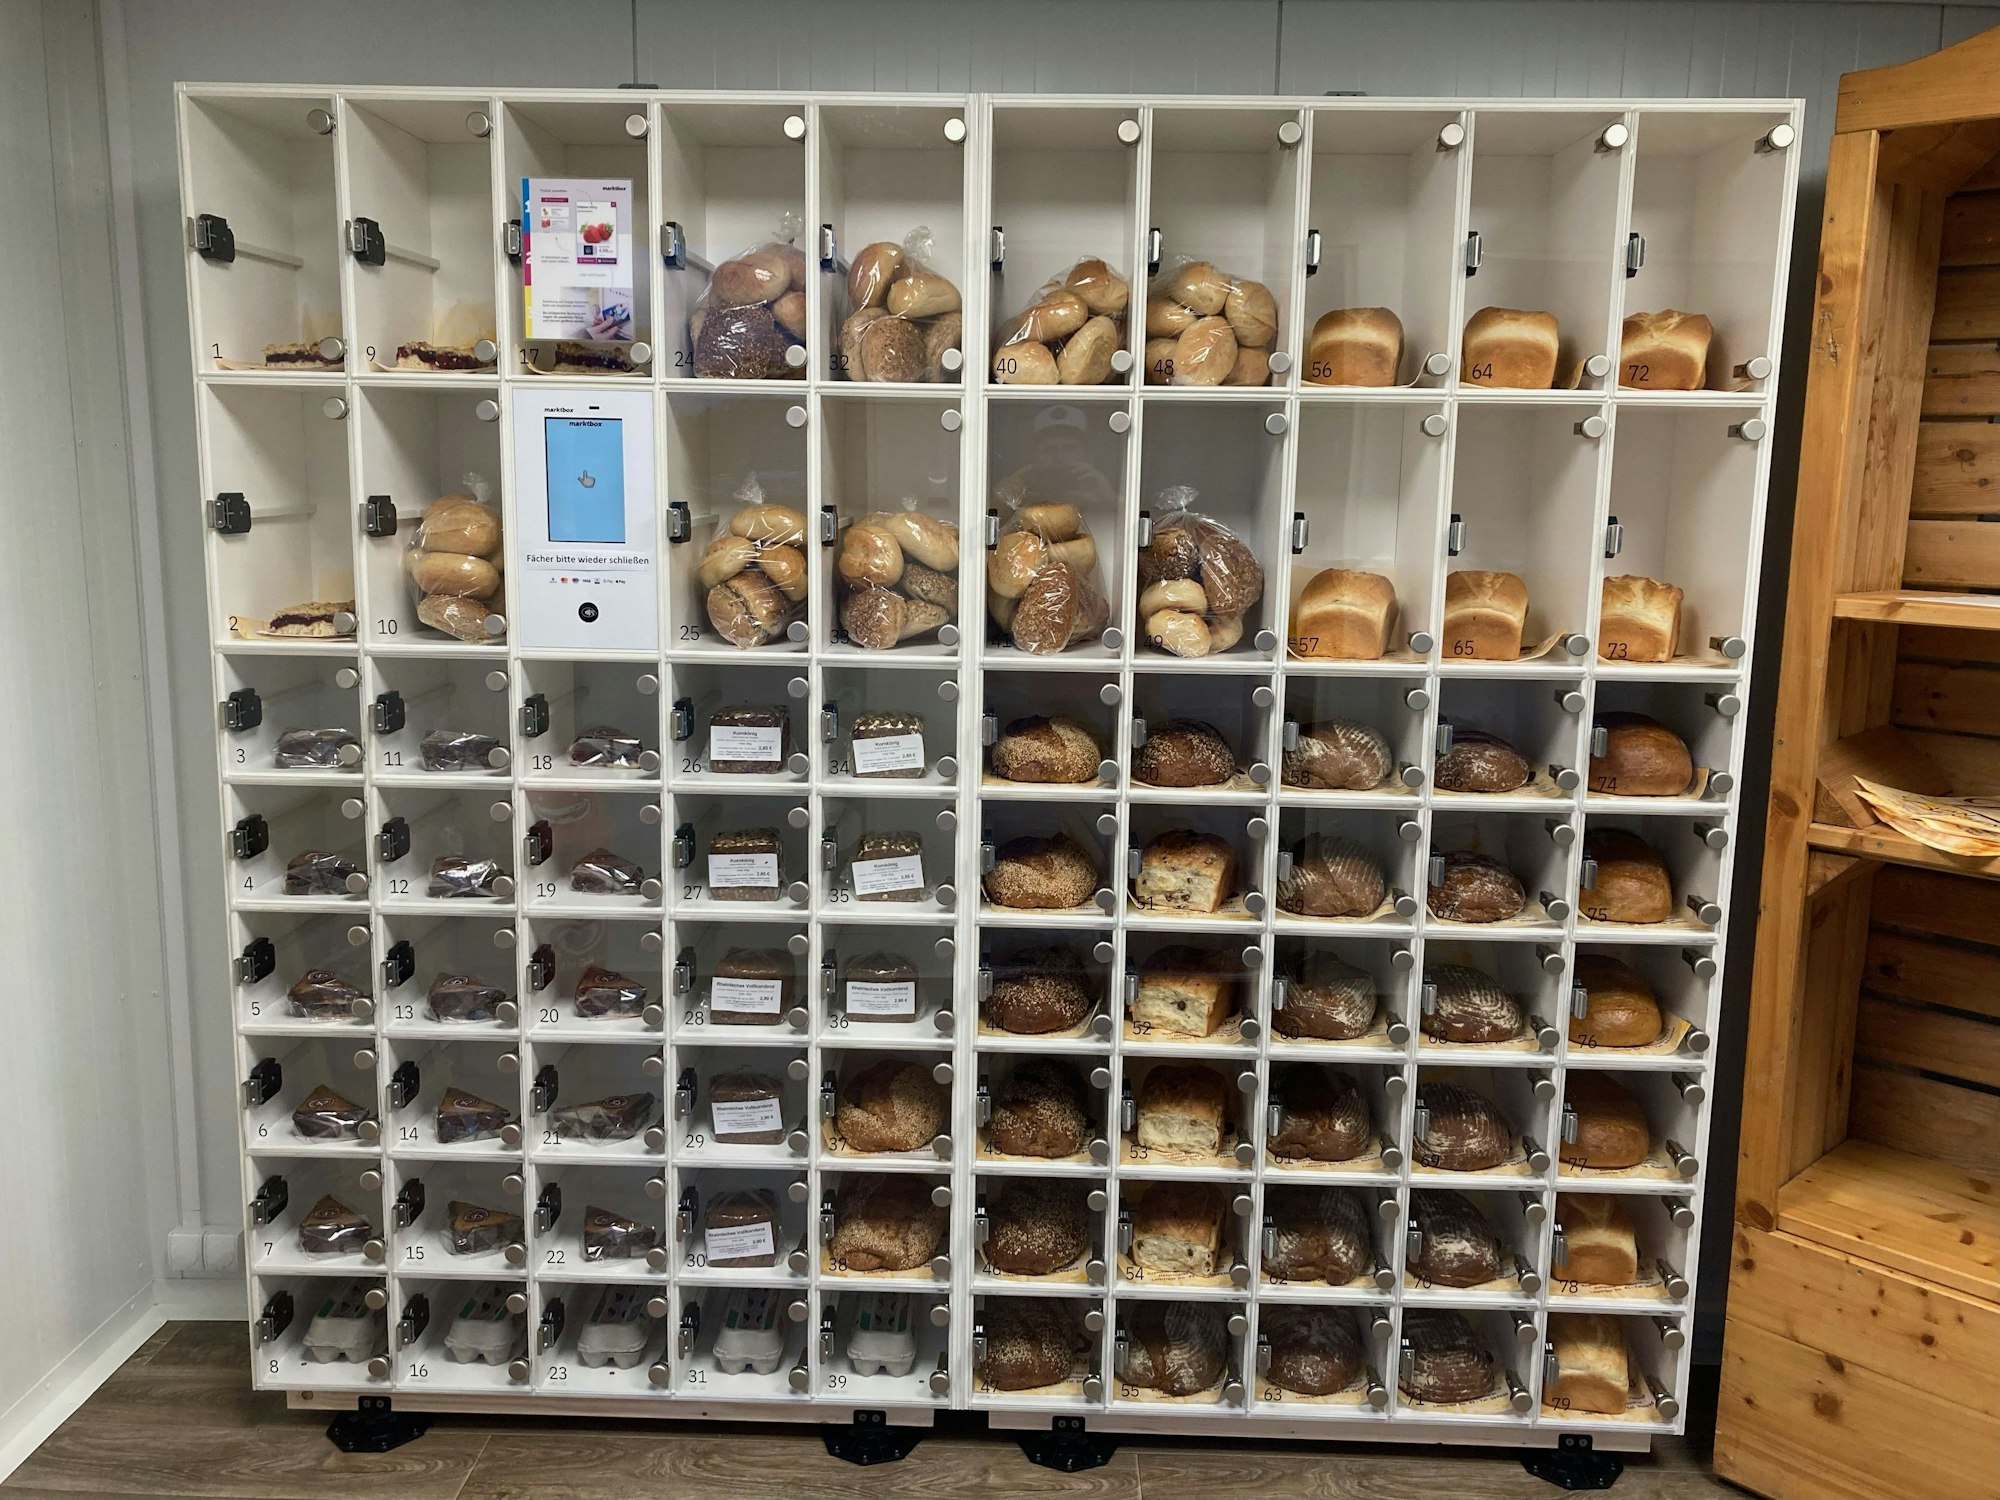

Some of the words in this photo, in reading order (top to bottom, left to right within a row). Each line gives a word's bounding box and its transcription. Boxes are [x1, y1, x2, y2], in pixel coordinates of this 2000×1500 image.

[212, 343, 223, 359] 1
[366, 346, 376, 361] 9
[519, 349, 539, 365] 17
[674, 351, 695, 367] 24
[829, 355, 850, 371] 32
[997, 358, 1017, 374] 40
[1153, 359, 1174, 375] 48
[1312, 361, 1332, 378] 56
[1472, 363, 1492, 379] 64
[1629, 365, 1649, 382] 72
[526, 555, 554, 563] Fächer
[556, 555, 575, 563] bitte
[609, 556, 649, 565] schließen
[229, 616, 238, 631] 2
[378, 619, 398, 635] 10
[680, 625, 700, 641] 25
[830, 629, 849, 644] 33
[1143, 634, 1163, 648] 49
[1299, 637, 1319, 652] 57
[1454, 640, 1474, 655] 65
[1607, 643, 1627, 658] 73
[236, 748, 245, 763] 3
[384, 751, 404, 766] 11
[533, 755, 552, 770] 18
[682, 758, 702, 773] 26
[830, 760, 849, 774] 34
[991, 764, 1010, 779] 42
[1140, 767, 1159, 781] 50
[1291, 771, 1310, 785] 58
[1443, 773, 1463, 788] 66
[1598, 776, 1617, 792] 74
[244, 876, 253, 890] 4
[390, 879, 409, 894] 12
[537, 883, 556, 897] 19
[683, 886, 702, 900] 27
[830, 888, 849, 902] 35
[1137, 896, 1156, 910] 51
[1285, 899, 1304, 913] 59
[1588, 907, 1607, 921] 75
[251, 1002, 260, 1015] 5
[395, 1005, 413, 1019] 13
[540, 1008, 559, 1022] 20
[685, 1011, 704, 1025] 28
[830, 1014, 849, 1028] 36
[986, 1017, 1004, 1030] 44
[1133, 1021, 1151, 1035] 52
[1280, 1026, 1299, 1039] 60
[1429, 1030, 1448, 1044] 68
[1578, 1034, 1596, 1048] 76
[258, 1123, 267, 1137] 6
[400, 1127, 418, 1140] 14
[543, 1131, 561, 1144] 21
[686, 1135, 704, 1148] 29
[829, 1137, 847, 1151] 37
[984, 1141, 1003, 1155] 45
[1130, 1145, 1148, 1159] 53
[1274, 1151, 1293, 1164] 61
[1421, 1154, 1440, 1167] 69
[1569, 1157, 1587, 1171] 77
[264, 1243, 273, 1255] 7
[406, 1246, 424, 1259] 15
[547, 1251, 565, 1264] 22
[687, 1254, 705, 1267] 30
[829, 1258, 847, 1271] 38
[982, 1262, 1001, 1275] 46
[1126, 1267, 1144, 1280] 54
[1270, 1271, 1288, 1285] 62
[1413, 1275, 1432, 1289] 70
[1560, 1280, 1578, 1293] 78
[270, 1360, 279, 1373] 8
[410, 1364, 428, 1377] 16
[549, 1367, 567, 1380] 23
[689, 1370, 707, 1383] 31
[828, 1375, 847, 1388] 39
[1121, 1384, 1139, 1397] 55
[1264, 1388, 1282, 1401] 63
[1407, 1393, 1424, 1405] 71
[1552, 1397, 1570, 1410] 79
